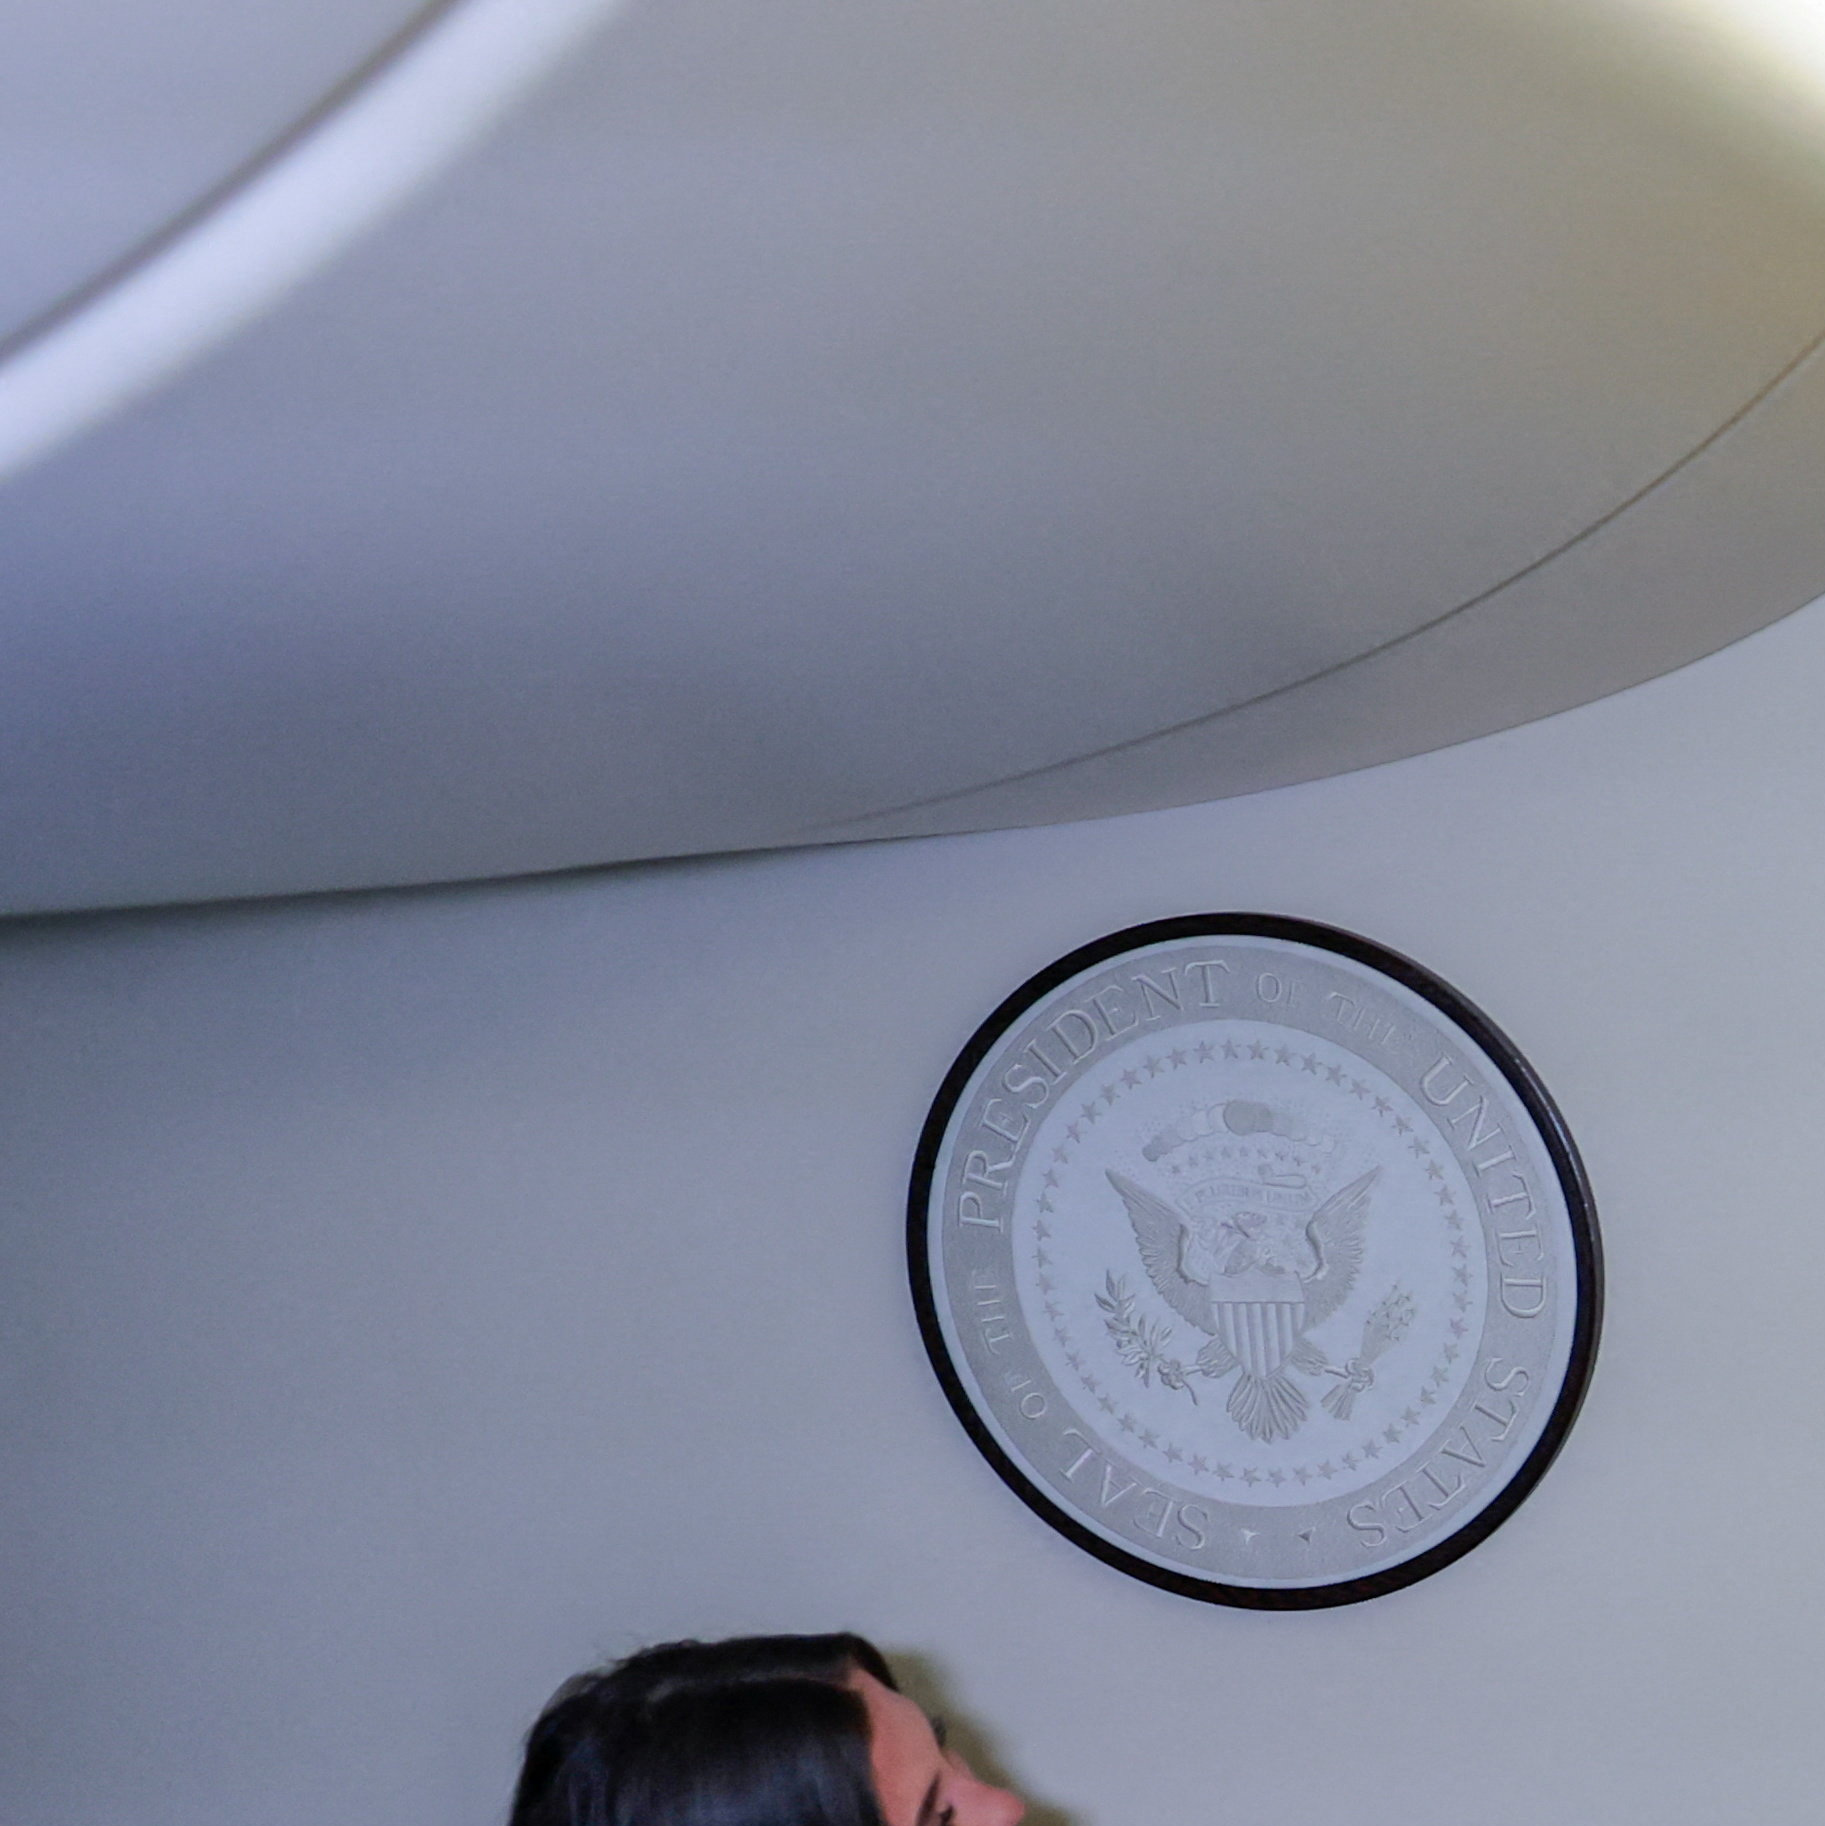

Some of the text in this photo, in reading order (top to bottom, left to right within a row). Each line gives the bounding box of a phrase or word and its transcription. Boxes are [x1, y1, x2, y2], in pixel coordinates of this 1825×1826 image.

[957, 959, 1232, 1234] PRESIDENT
[1419, 1053, 1545, 1320] UNITED
[1058, 1427, 1209, 1550] SEAL
[1346, 1356, 1531, 1550] STATES
